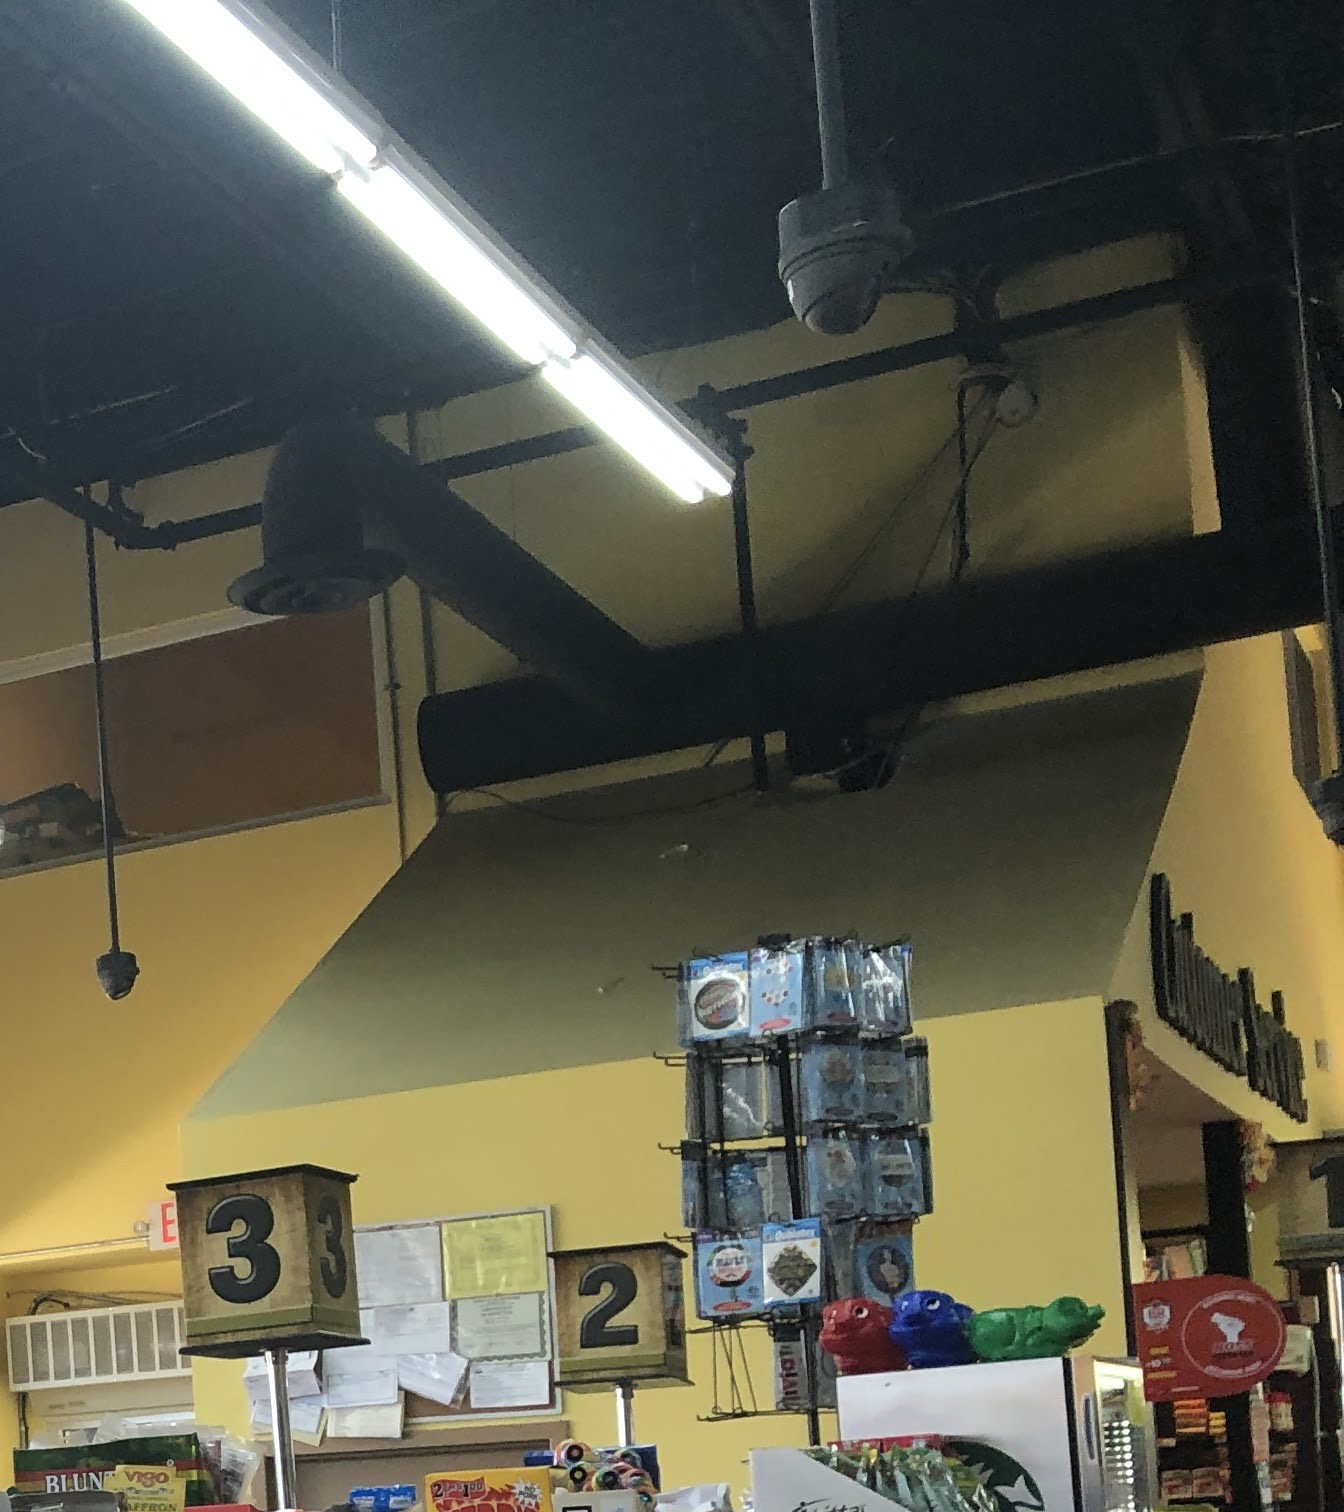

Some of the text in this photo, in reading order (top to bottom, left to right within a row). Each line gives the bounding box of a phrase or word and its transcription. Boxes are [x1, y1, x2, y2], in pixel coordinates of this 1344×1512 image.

[205, 1192, 283, 1304] 3
[316, 1192, 347, 1300] 3
[577, 1261, 639, 1350] 2
[45, 1470, 116, 1494] BLUN
